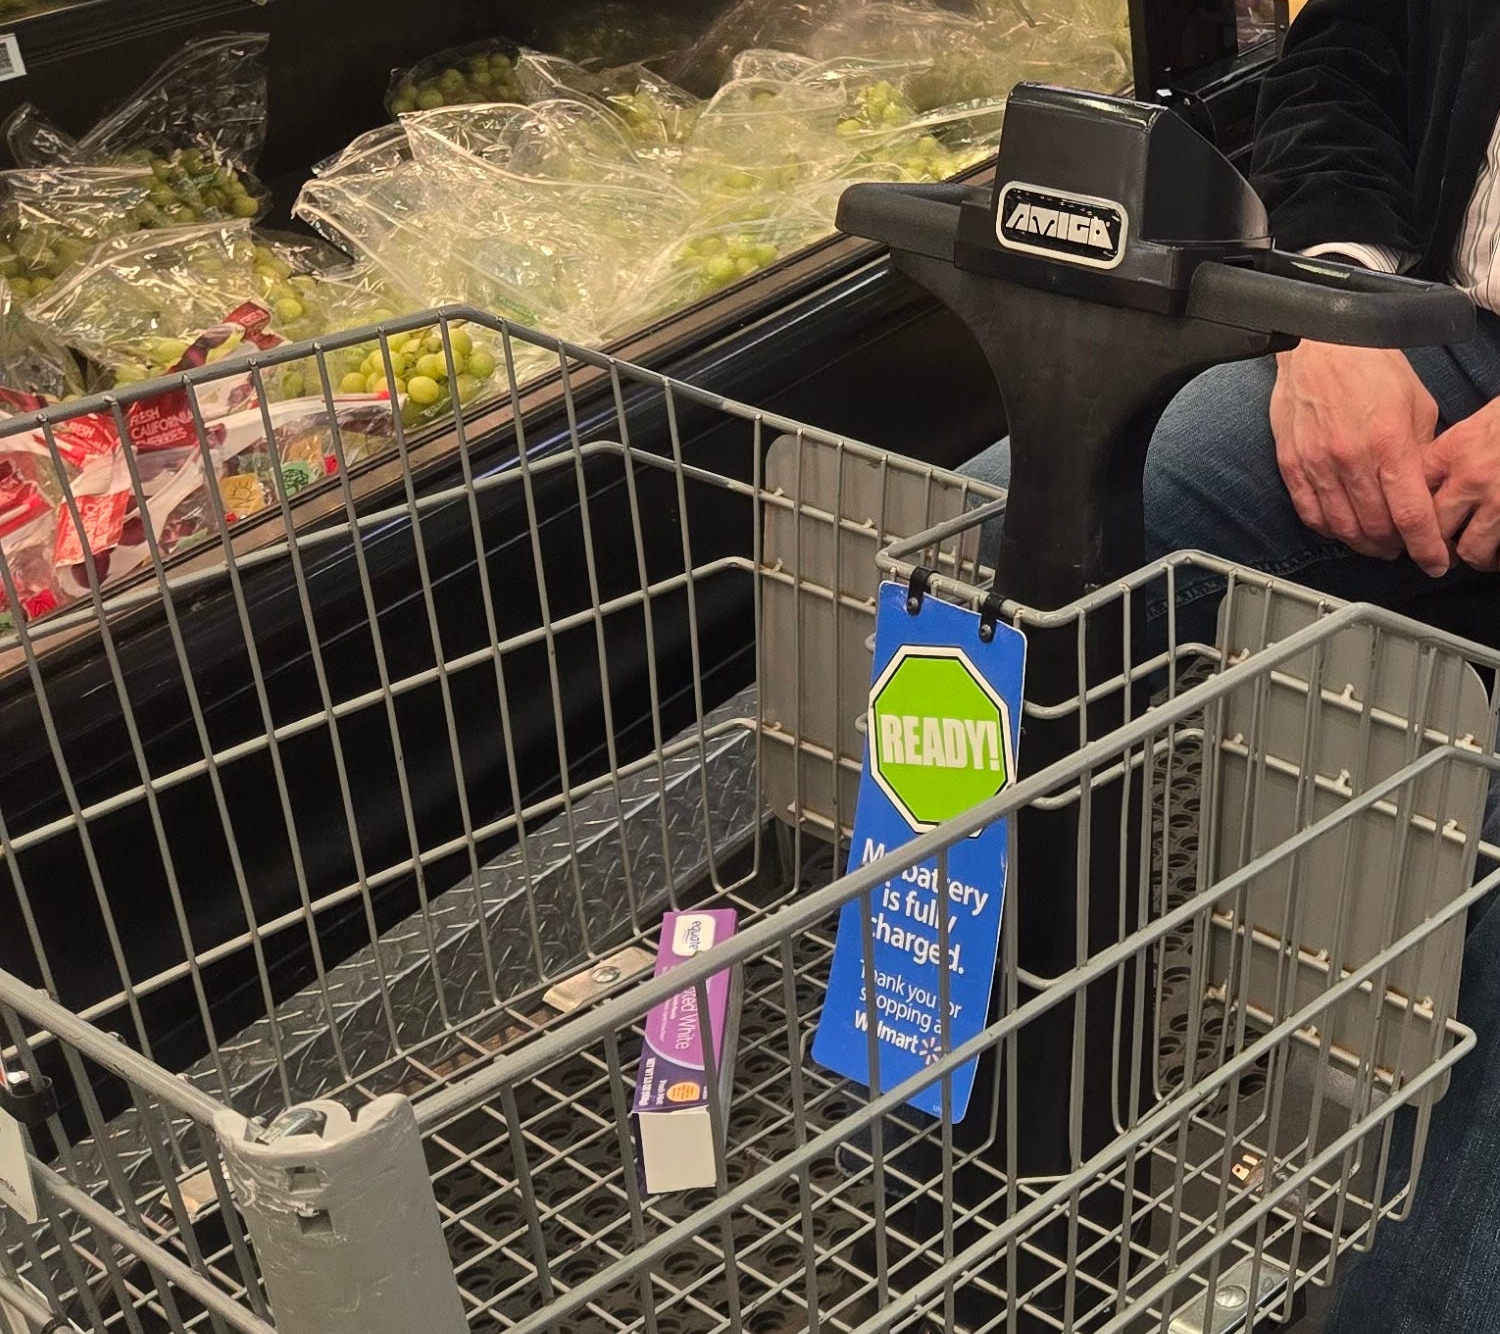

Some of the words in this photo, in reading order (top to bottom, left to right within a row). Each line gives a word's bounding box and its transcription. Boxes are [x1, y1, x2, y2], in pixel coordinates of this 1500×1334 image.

[130, 407, 160, 427] FRESH
[881, 714, 1000, 771] READY!
[882, 881, 901, 911] is
[902, 866, 989, 916] batery
[688, 920, 703, 955] equate
[859, 987, 932, 1033] sopping
[905, 984, 937, 1009] you
[675, 1011, 698, 1051] White
[855, 1009, 919, 1054] Wlmart
